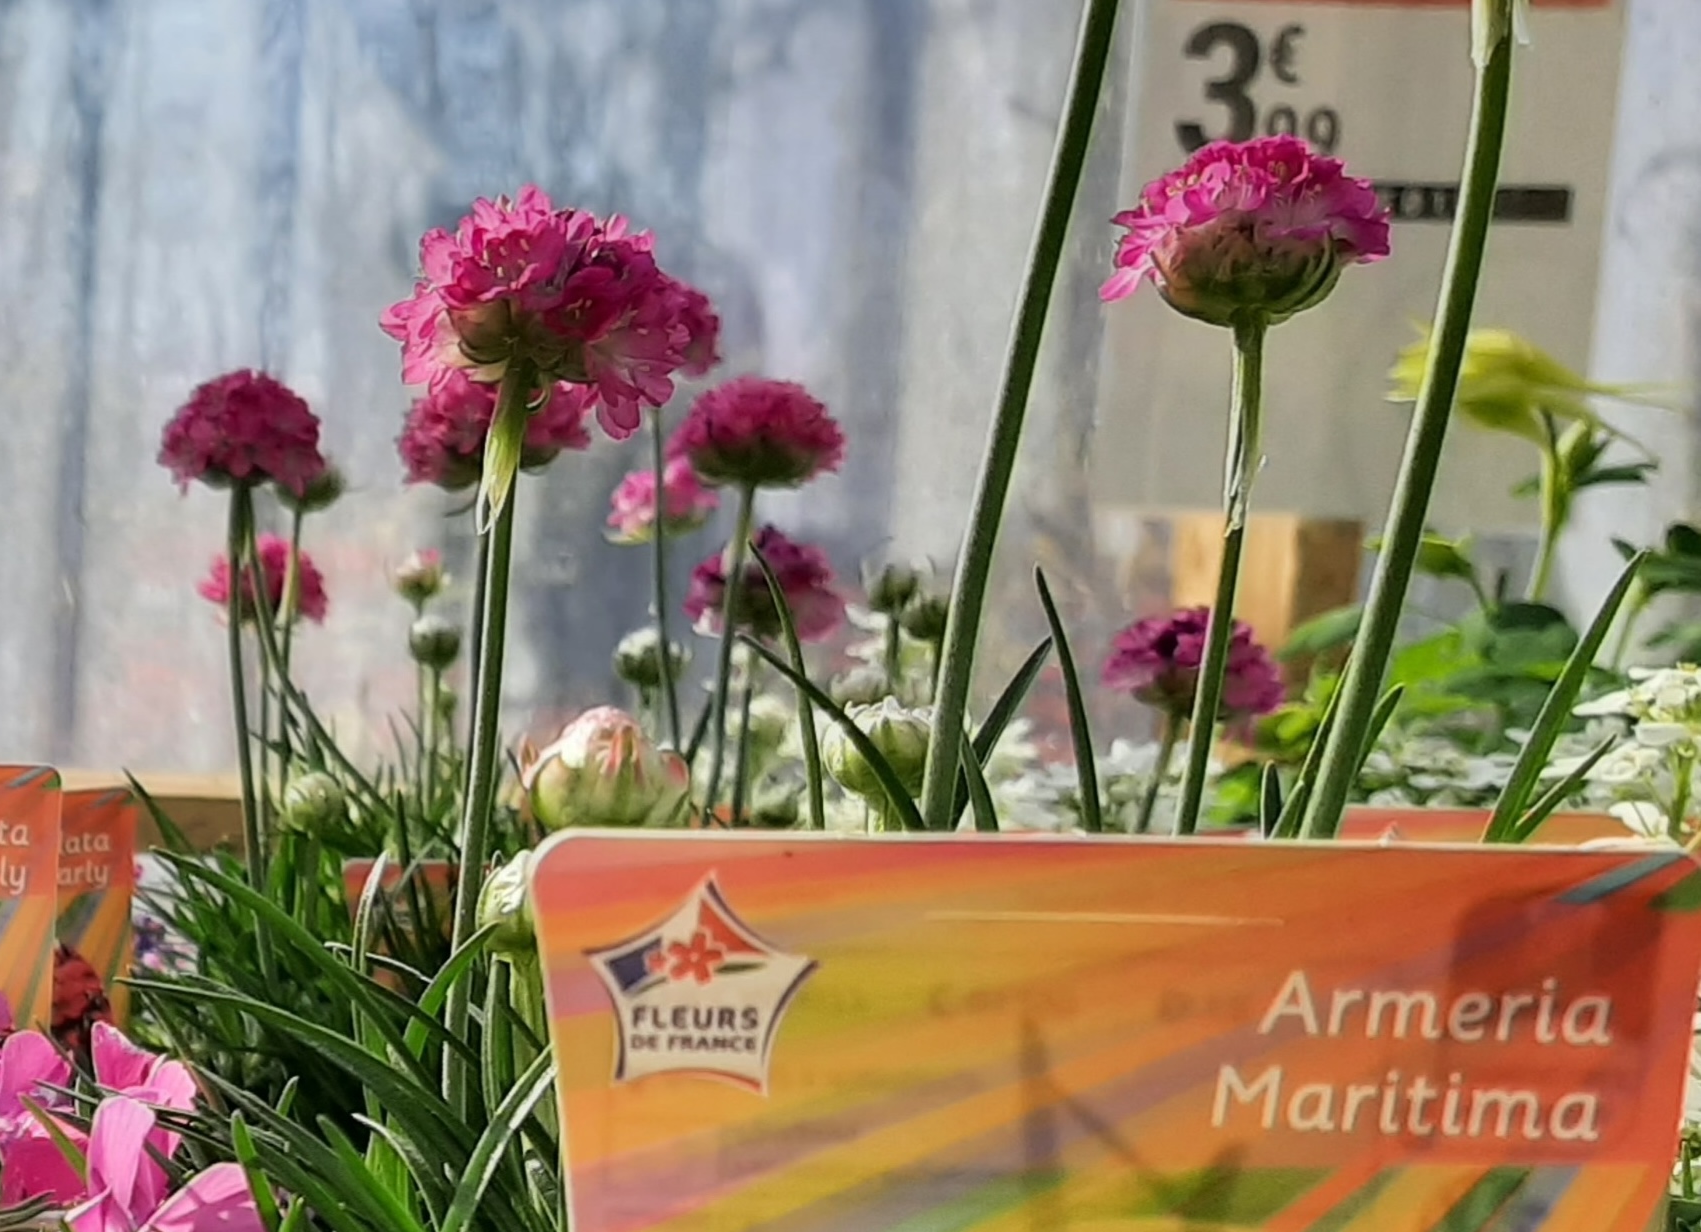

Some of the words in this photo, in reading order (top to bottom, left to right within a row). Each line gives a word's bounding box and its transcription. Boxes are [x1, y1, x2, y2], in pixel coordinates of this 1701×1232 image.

[1175, 22, 1259, 153] 3
[57, 861, 109, 889] arly
[631, 1006, 759, 1030] FLEURS
[1258, 969, 1613, 1044] Armeria
[631, 1034, 658, 1050] DE
[668, 1034, 757, 1052] FRANCE
[1211, 1064, 1600, 1140] Maritima
